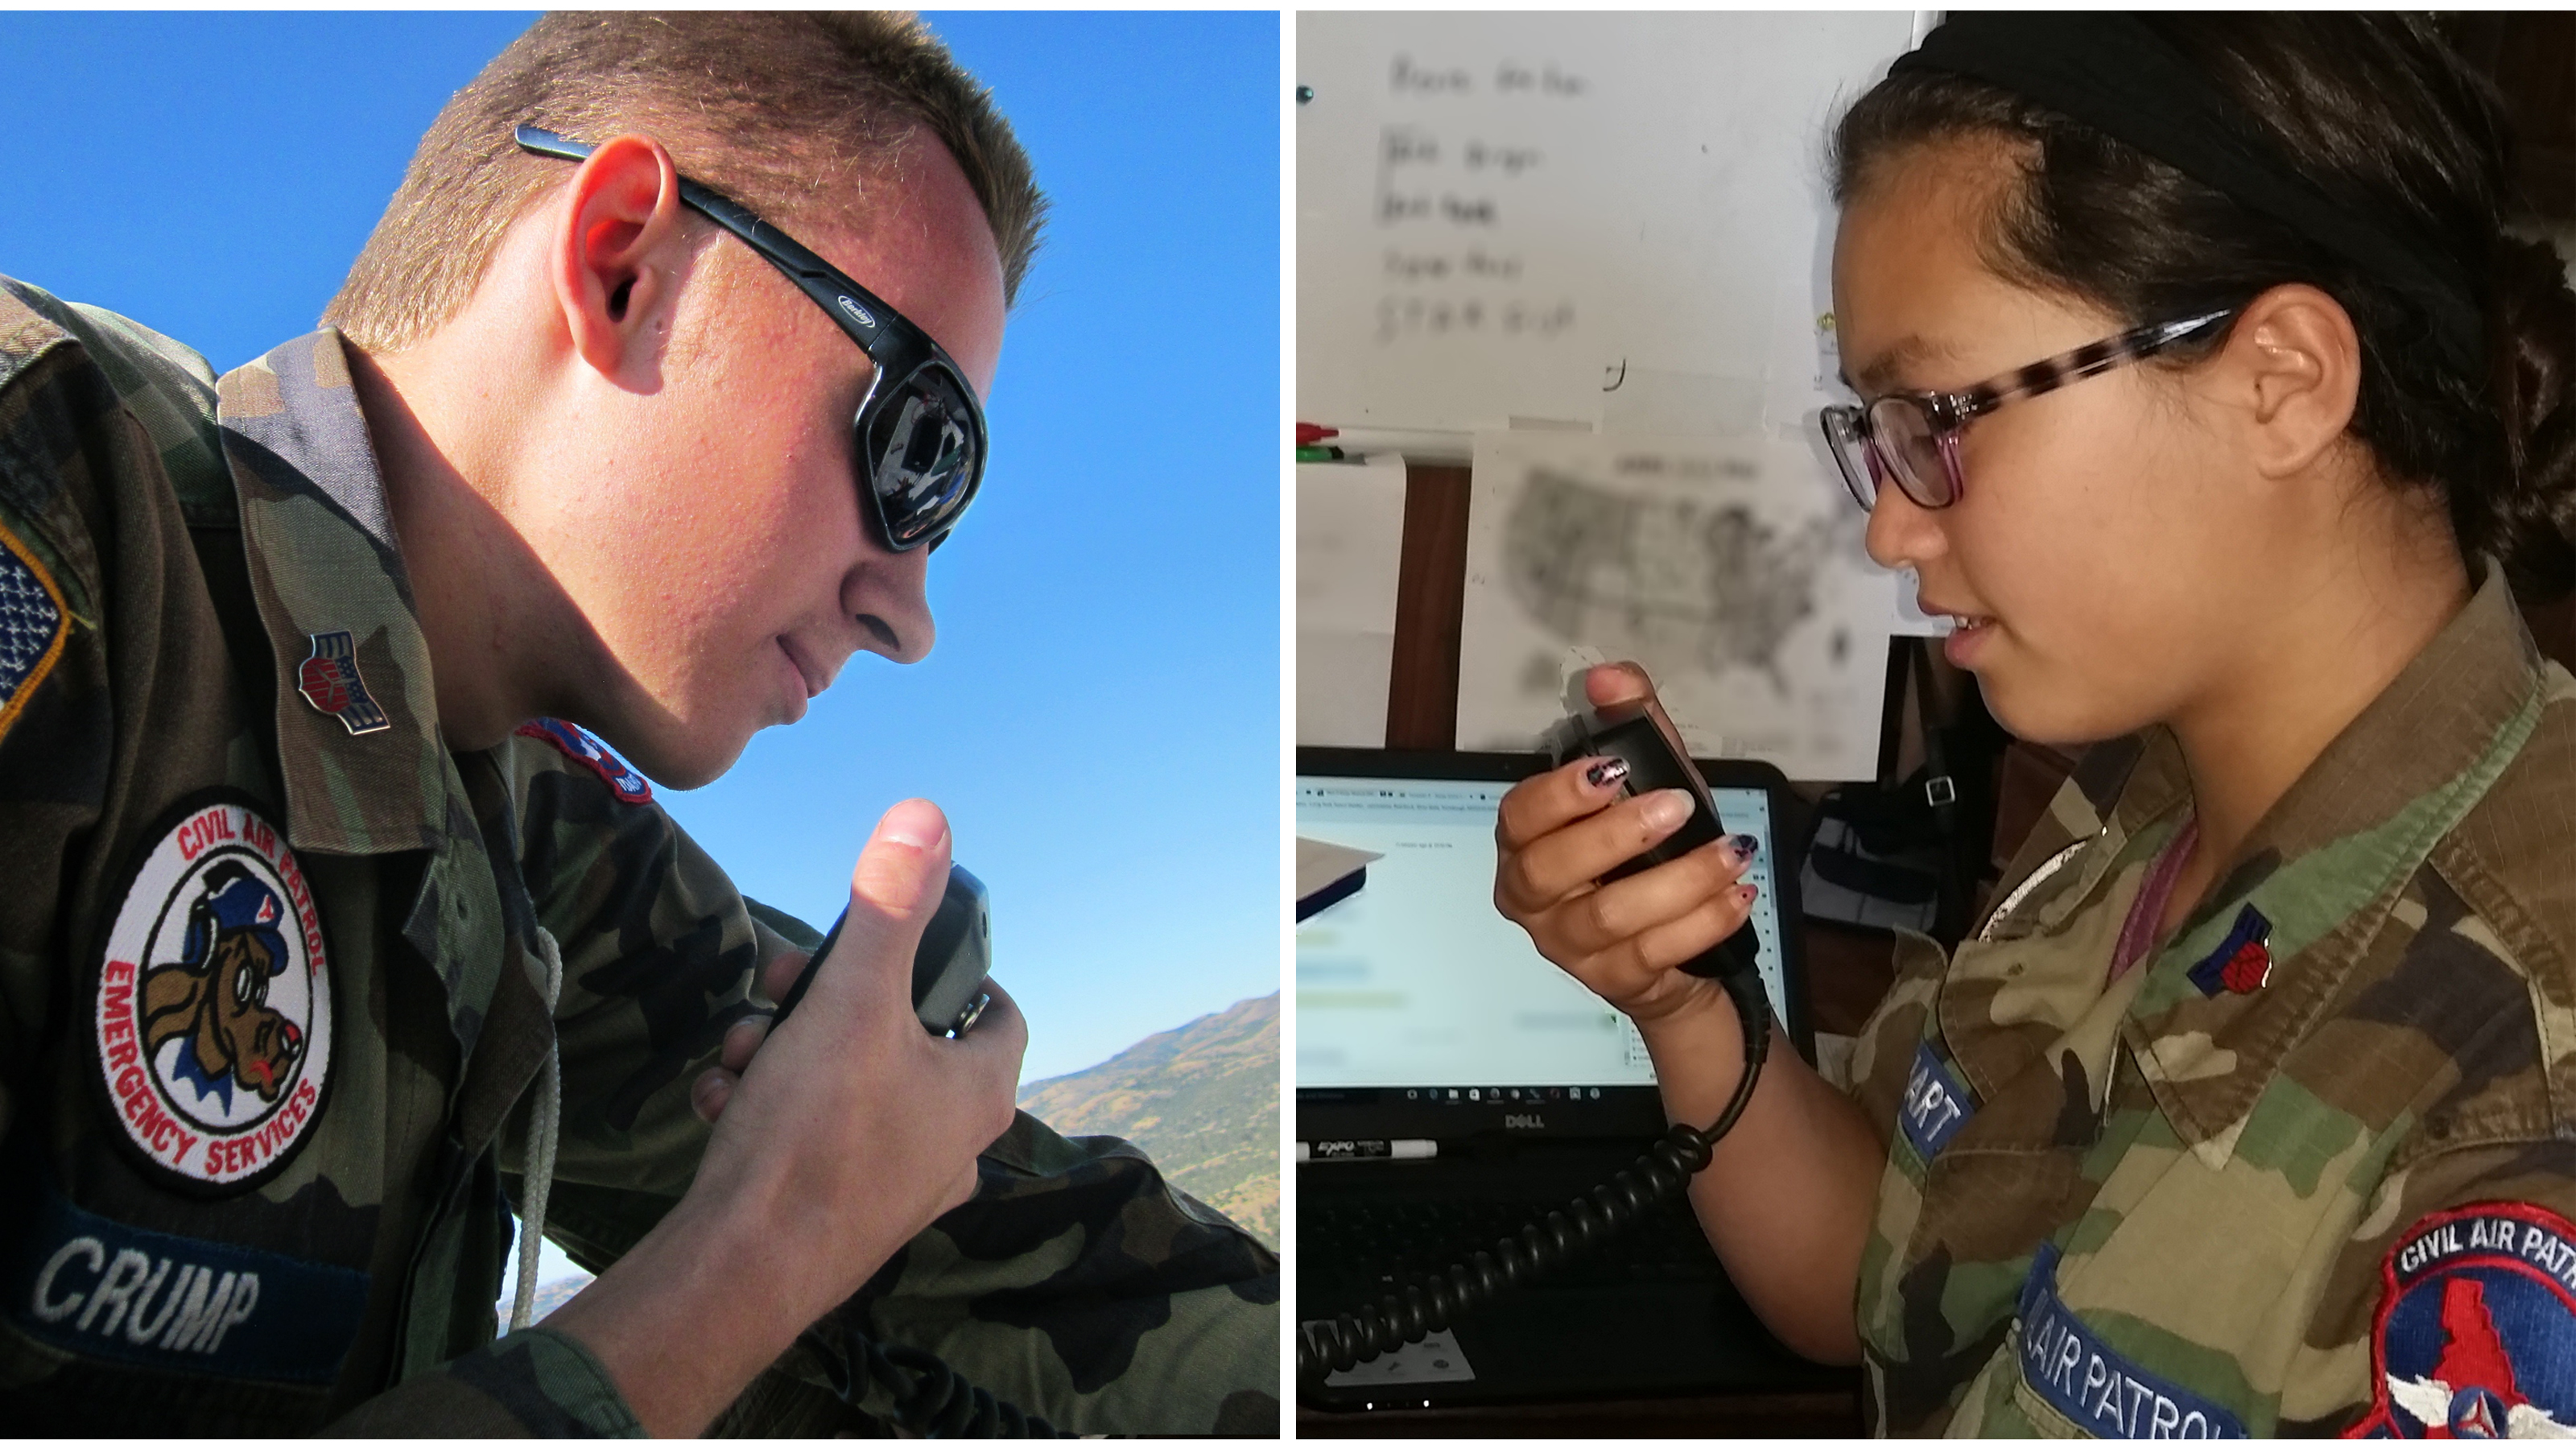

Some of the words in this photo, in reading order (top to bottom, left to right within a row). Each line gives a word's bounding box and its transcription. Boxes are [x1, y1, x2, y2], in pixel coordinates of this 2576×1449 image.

[176, 808, 236, 861] CIVIL
[243, 812, 275, 860] AIR
[279, 849, 325, 976] PATROL
[103, 960, 199, 1166] EMERGENCY
[204, 1076, 316, 1176] SERVICES
[32, 1235, 260, 1356] CRUMP
[2401, 1224, 2464, 1274] CIVIL
[2469, 1218, 2516, 1253] AIR
